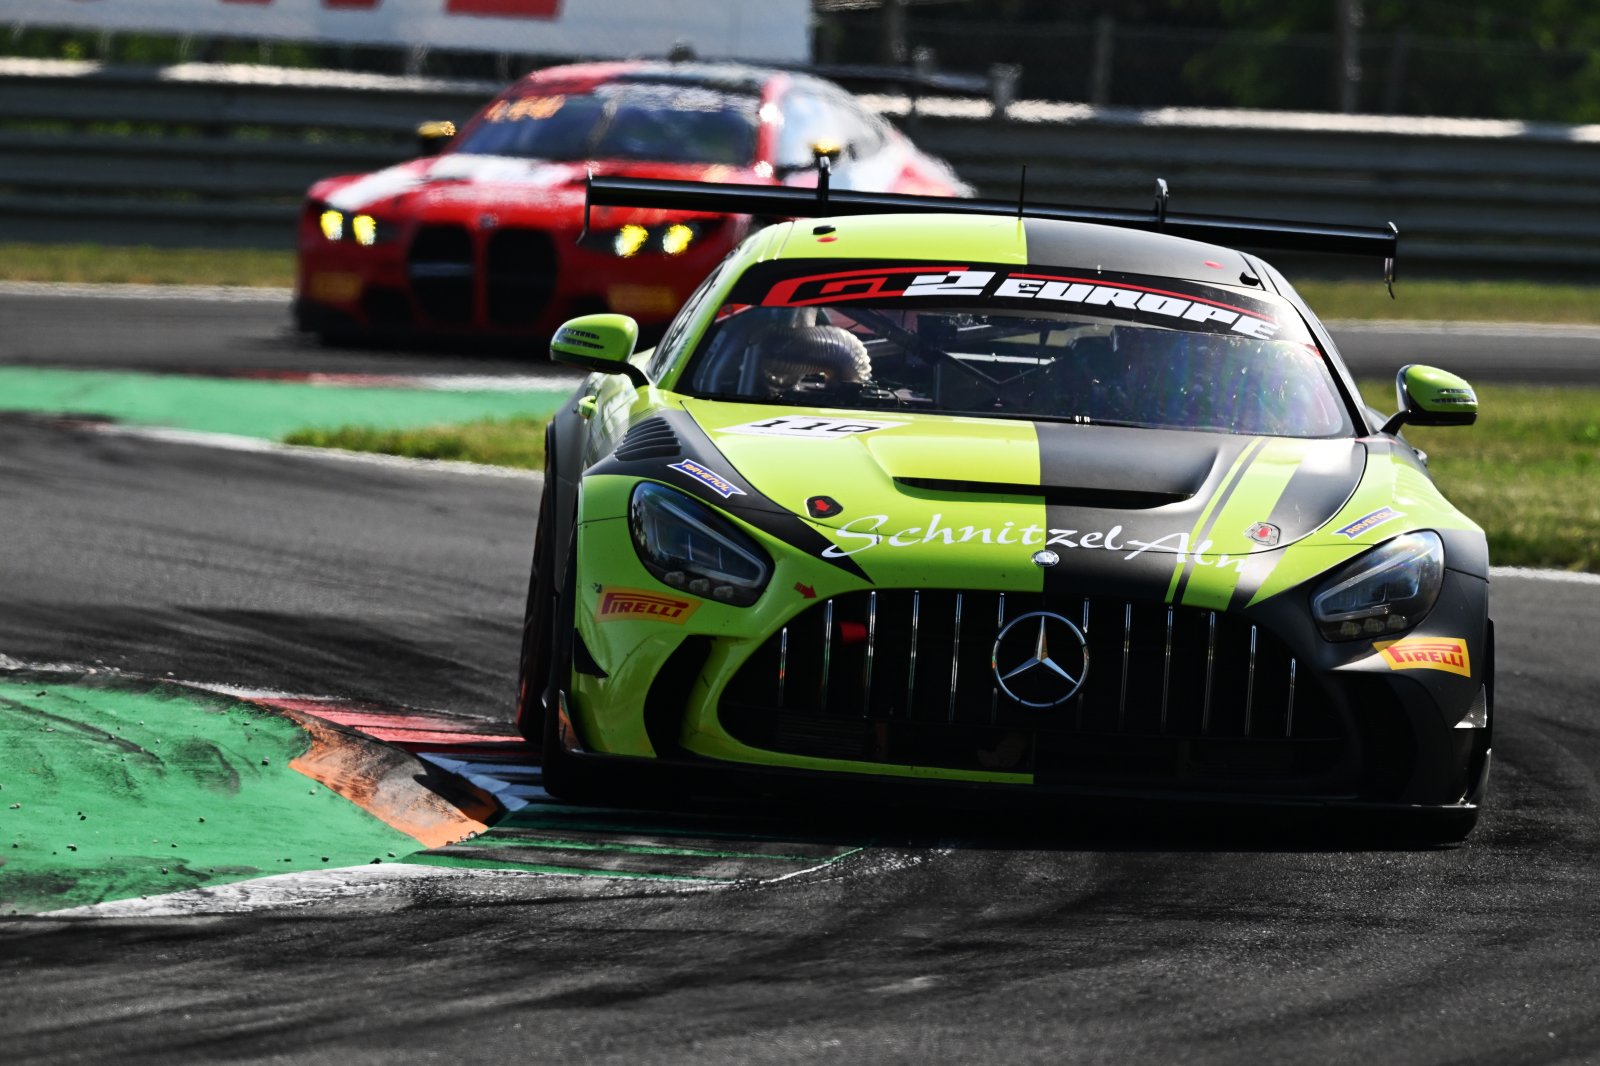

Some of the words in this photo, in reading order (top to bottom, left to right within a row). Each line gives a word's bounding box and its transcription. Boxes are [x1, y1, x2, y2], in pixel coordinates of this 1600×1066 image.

[993, 278, 1279, 340] EUROPE
[601, 592, 689, 618] PIRELLI
[1385, 643, 1464, 668] PIRELLI
